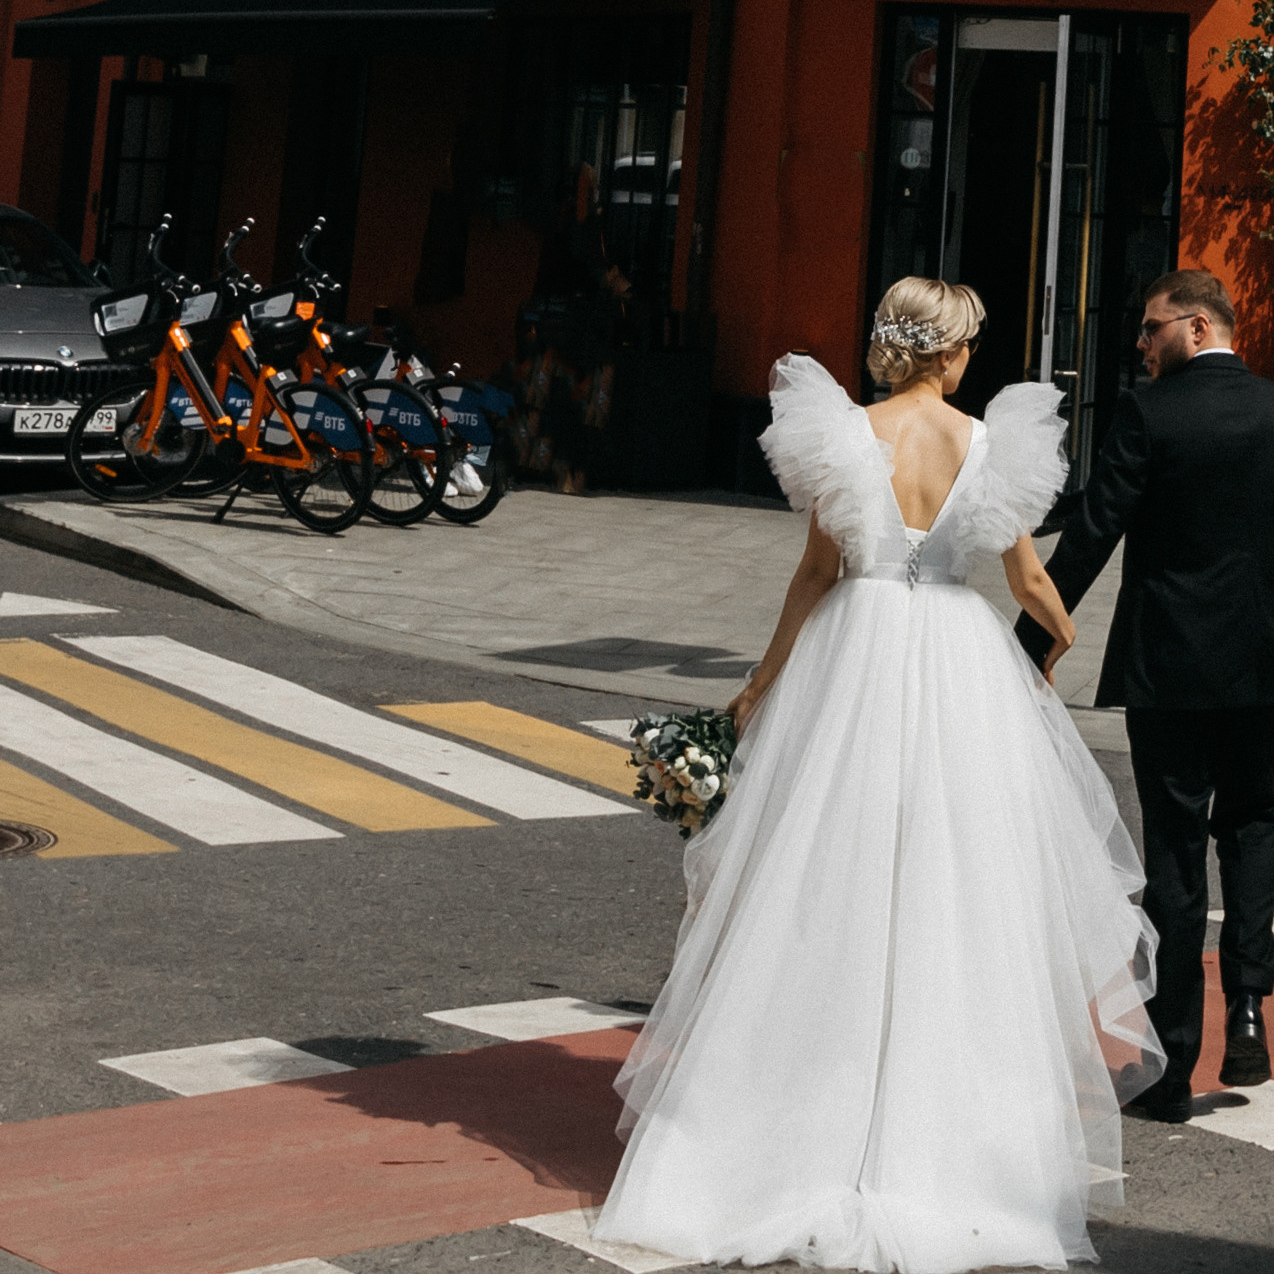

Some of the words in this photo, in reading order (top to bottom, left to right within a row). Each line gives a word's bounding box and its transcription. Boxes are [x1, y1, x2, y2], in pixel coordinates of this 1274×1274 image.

[20, 412, 74, 429] К278А
[324, 416, 346, 432] ВТБ
[398, 411, 422, 427] ВТБ
